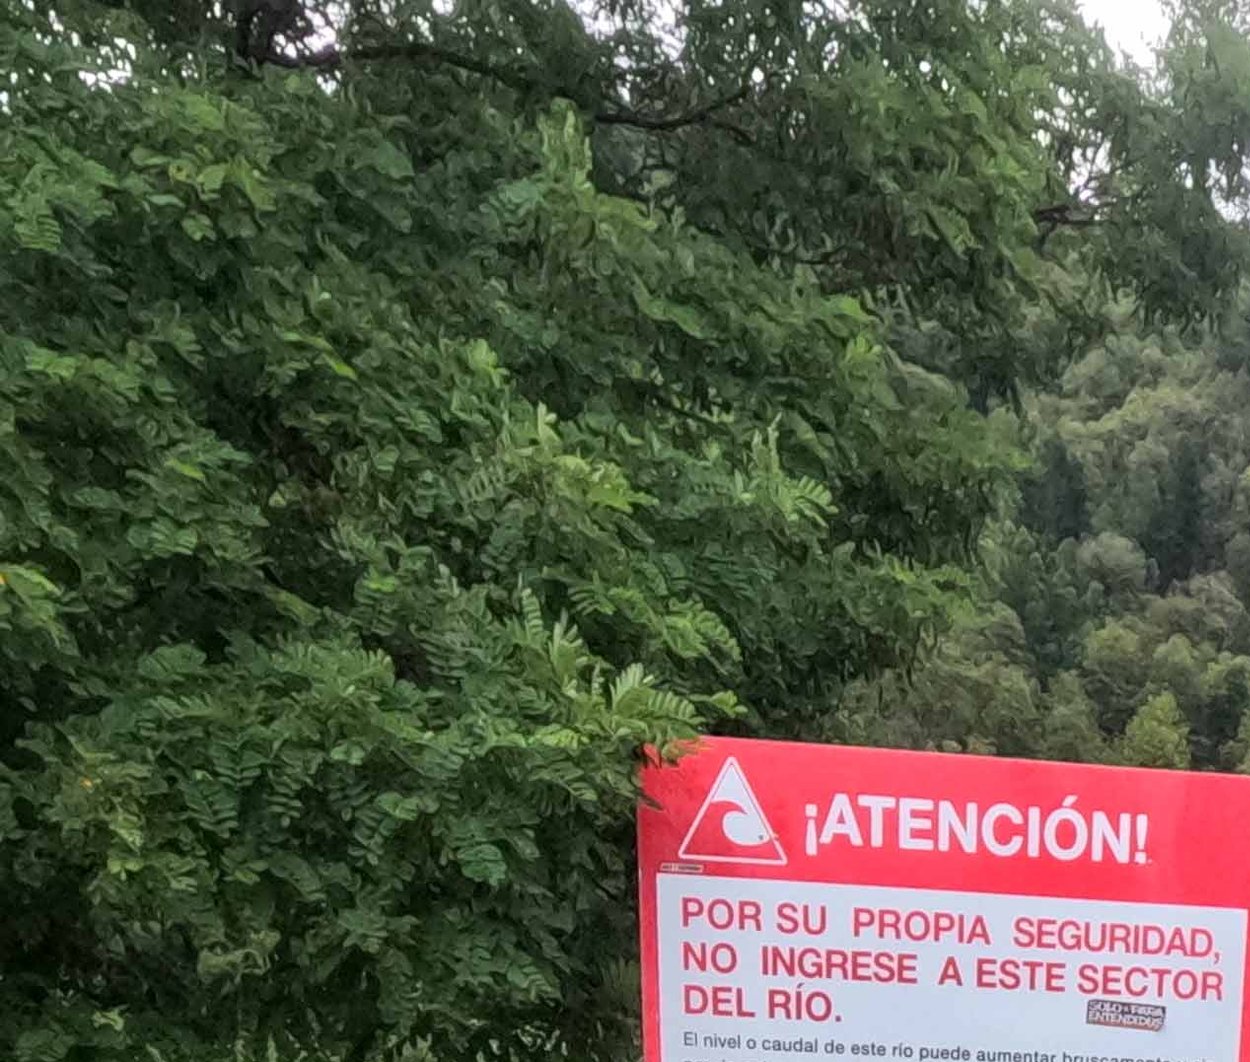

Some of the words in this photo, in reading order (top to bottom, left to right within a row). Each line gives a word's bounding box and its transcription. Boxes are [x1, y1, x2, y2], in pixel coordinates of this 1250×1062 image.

[805, 793, 1148, 865] ¡ATENCIÓN!
[682, 896, 762, 931] POR
[776, 903, 827, 935] SU
[854, 907, 991, 945] PROPIA
[1013, 916, 1221, 964] SEGURIDAD,
[682, 941, 738, 974] NO
[762, 945, 918, 984] INGRESE
[938, 956, 963, 987] A
[976, 958, 1066, 992] ESTE
[1077, 964, 1223, 1001] SECTOR
[684, 984, 756, 1018] DEL
[768, 982, 842, 1022] RÍO.
[683, 1032, 698, 1046] El
[703, 1033, 741, 1049] nivel
[746, 1038, 757, 1050] o
[761, 1037, 819, 1054] caudal
[824, 1039, 845, 1055] de
[850, 1042, 886, 1057] este
[892, 1043, 914, 1058] río
[919, 1046, 971, 1062] puede
